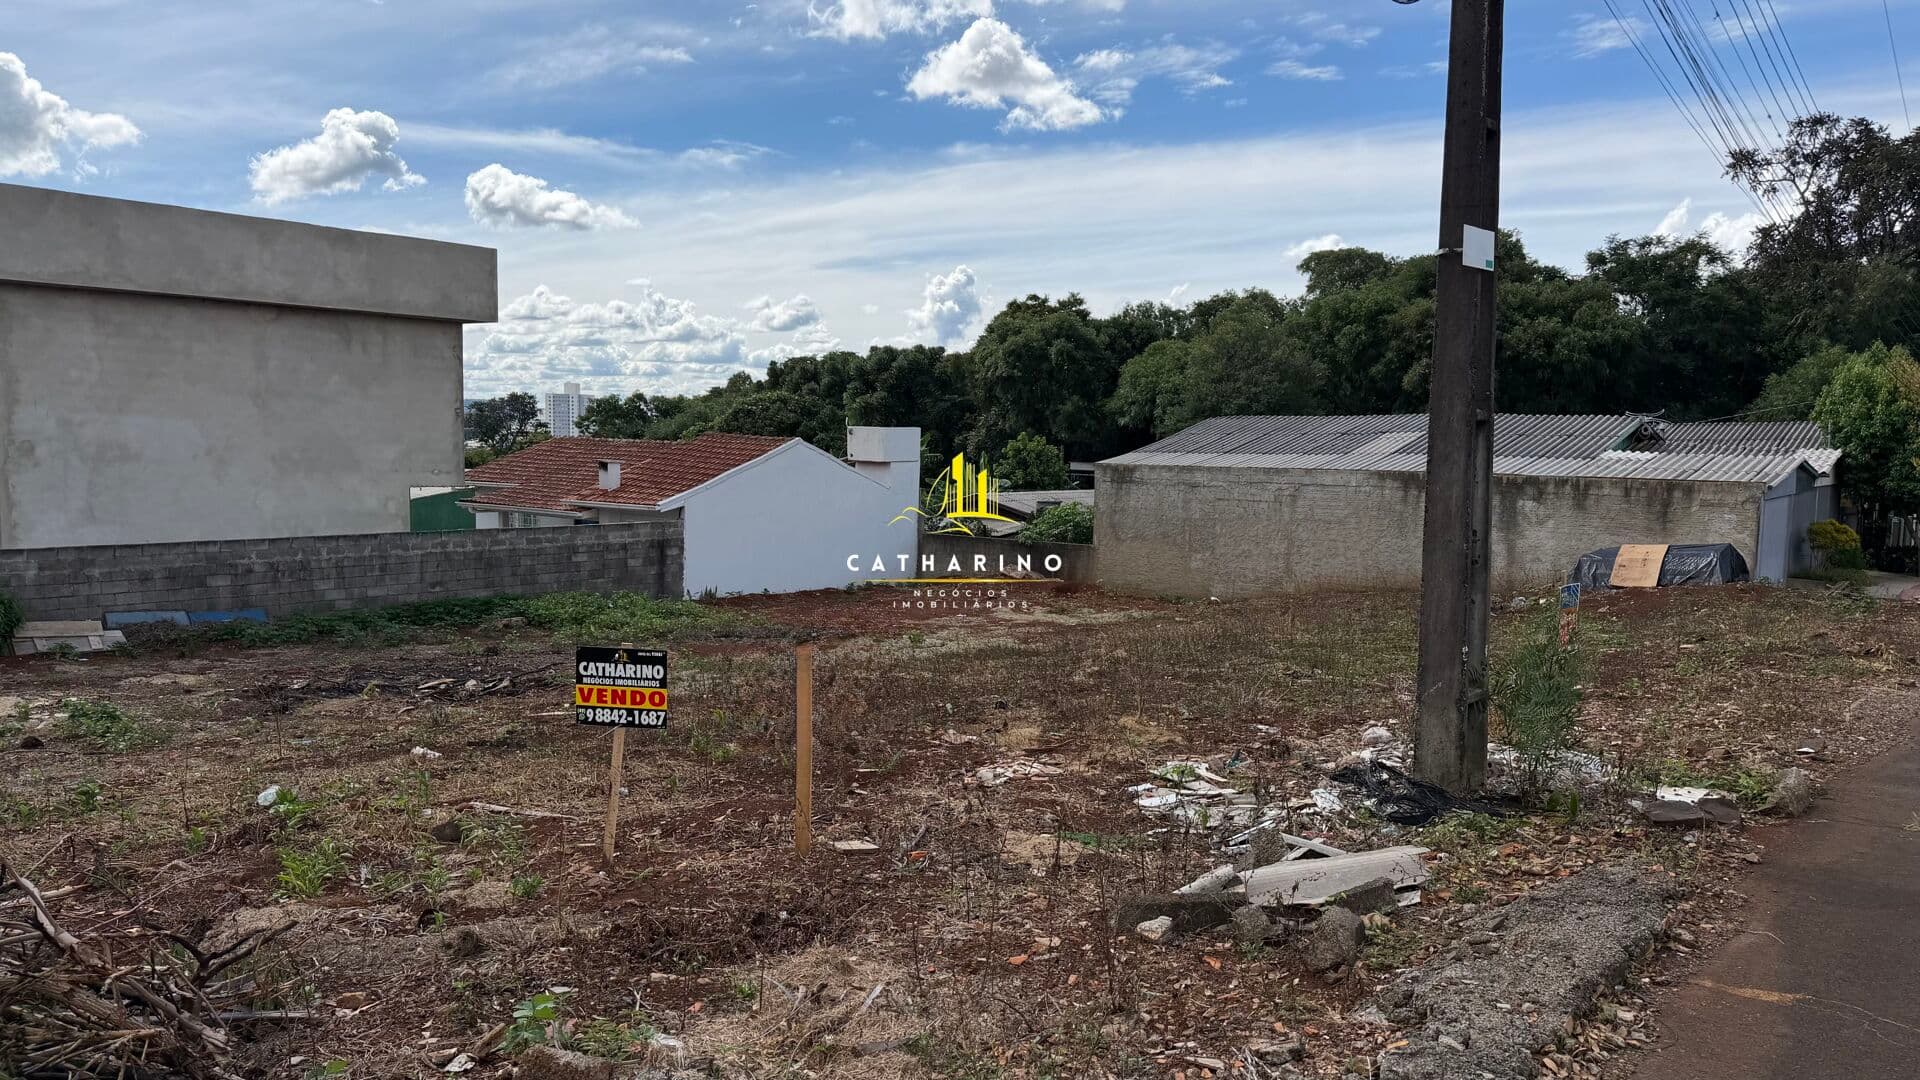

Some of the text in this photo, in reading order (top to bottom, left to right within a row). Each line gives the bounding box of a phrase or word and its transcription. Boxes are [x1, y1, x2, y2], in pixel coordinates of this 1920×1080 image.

[578, 661, 665, 679] CATHARINO
[582, 677, 660, 687] NEGÓCIOS IMOBILIÁRIOS
[578, 687, 666, 707] VENDO
[595, 708, 666, 726] 8842-1687
